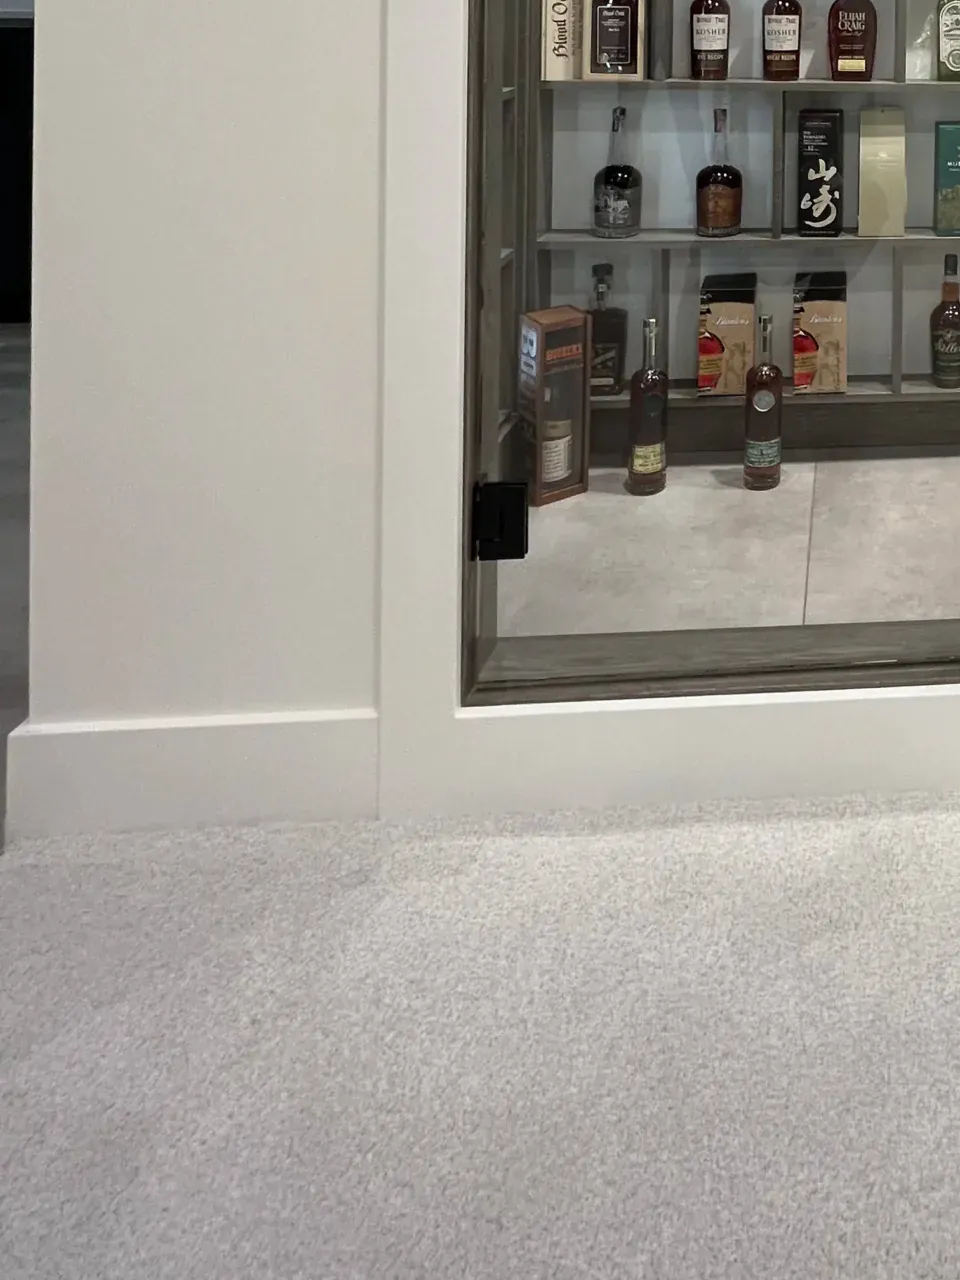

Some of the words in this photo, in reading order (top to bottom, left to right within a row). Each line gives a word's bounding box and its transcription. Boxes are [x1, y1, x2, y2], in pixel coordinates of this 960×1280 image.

[838, 10, 866, 21] ELIJAH
[838, 20, 866, 31] CRAIG
[552, 18, 568, 58] Blood
